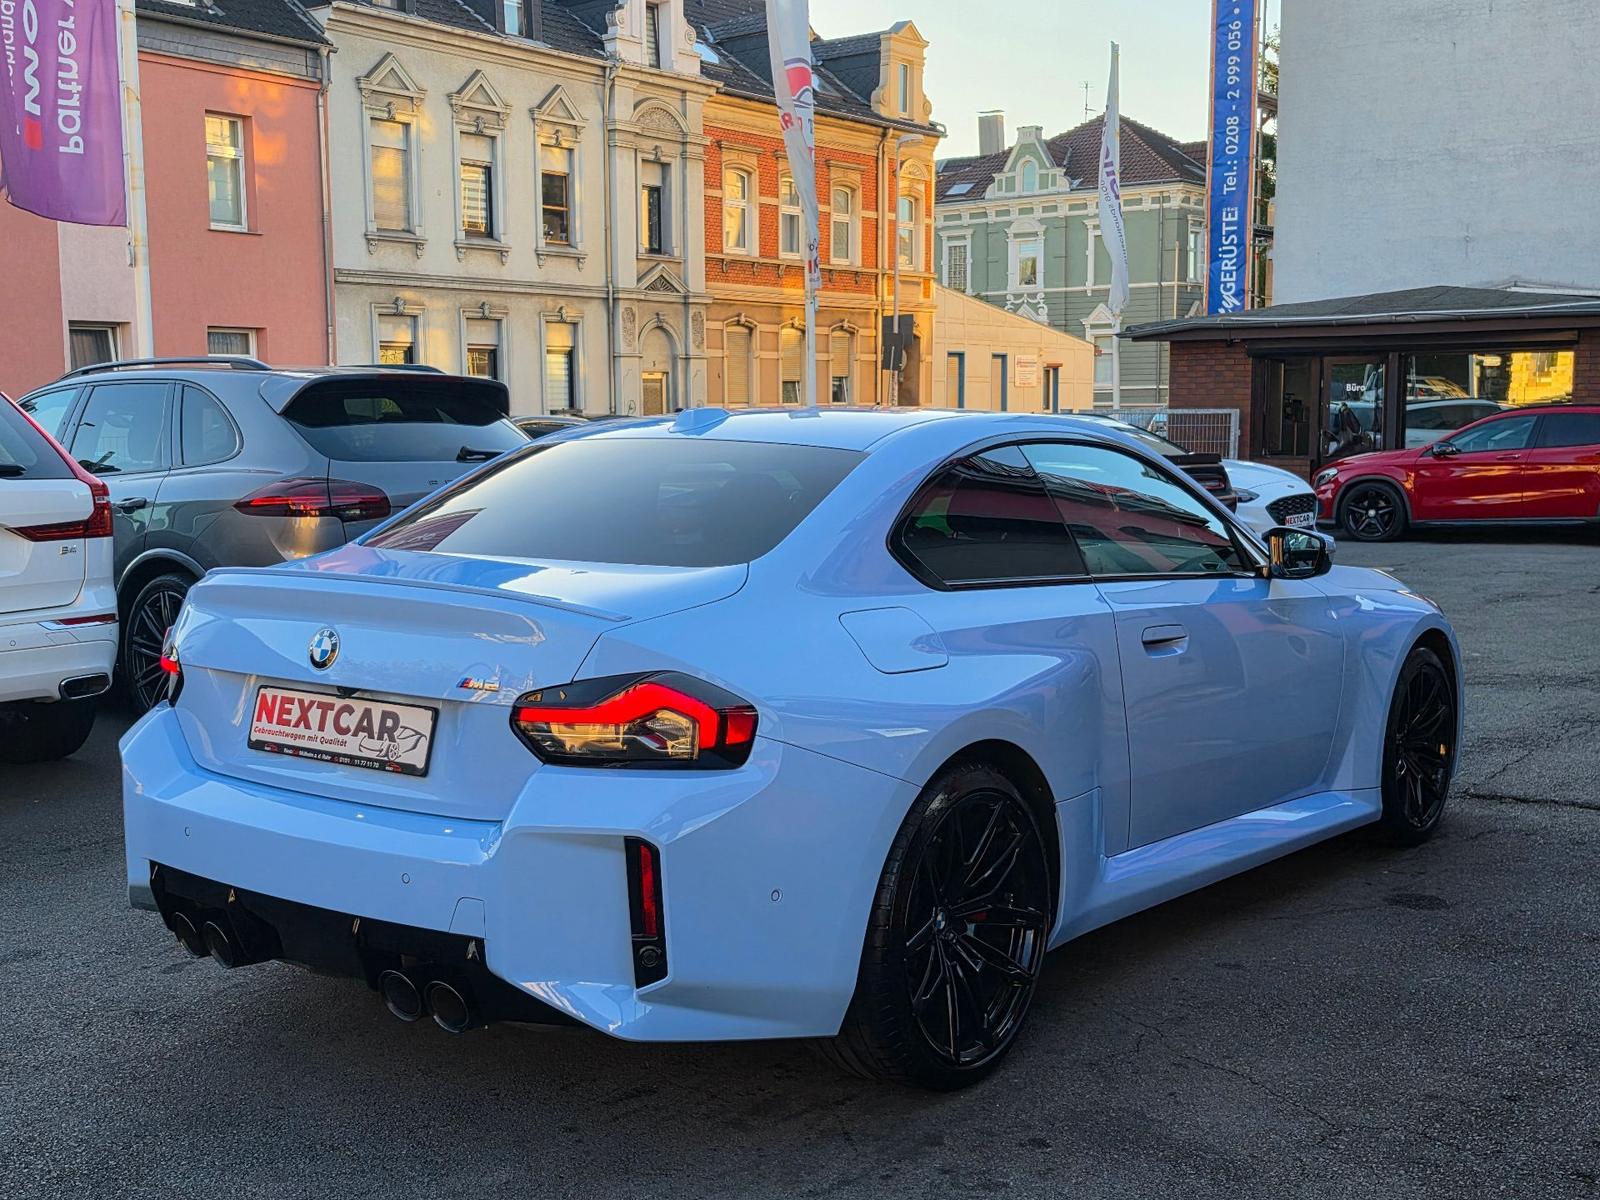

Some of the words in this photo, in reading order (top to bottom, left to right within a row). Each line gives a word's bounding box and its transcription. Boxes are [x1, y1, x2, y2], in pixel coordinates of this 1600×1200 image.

[1228, 20, 1241, 50] 056
[1227, 56, 1240, 85] 999
[1227, 89, 1239, 99] 2
[1225, 116, 1239, 155] 0208
[1223, 160, 1237, 195] Tel.:
[1346, 383, 1366, 391] Büro
[1285, 513, 1311, 525] NEXTCAR
[256, 693, 401, 742] NEXTCAR
[254, 726, 305, 740] Gebrauchtwagen
[306, 734, 319, 743] mit
[320, 736, 347, 747] Qualität
